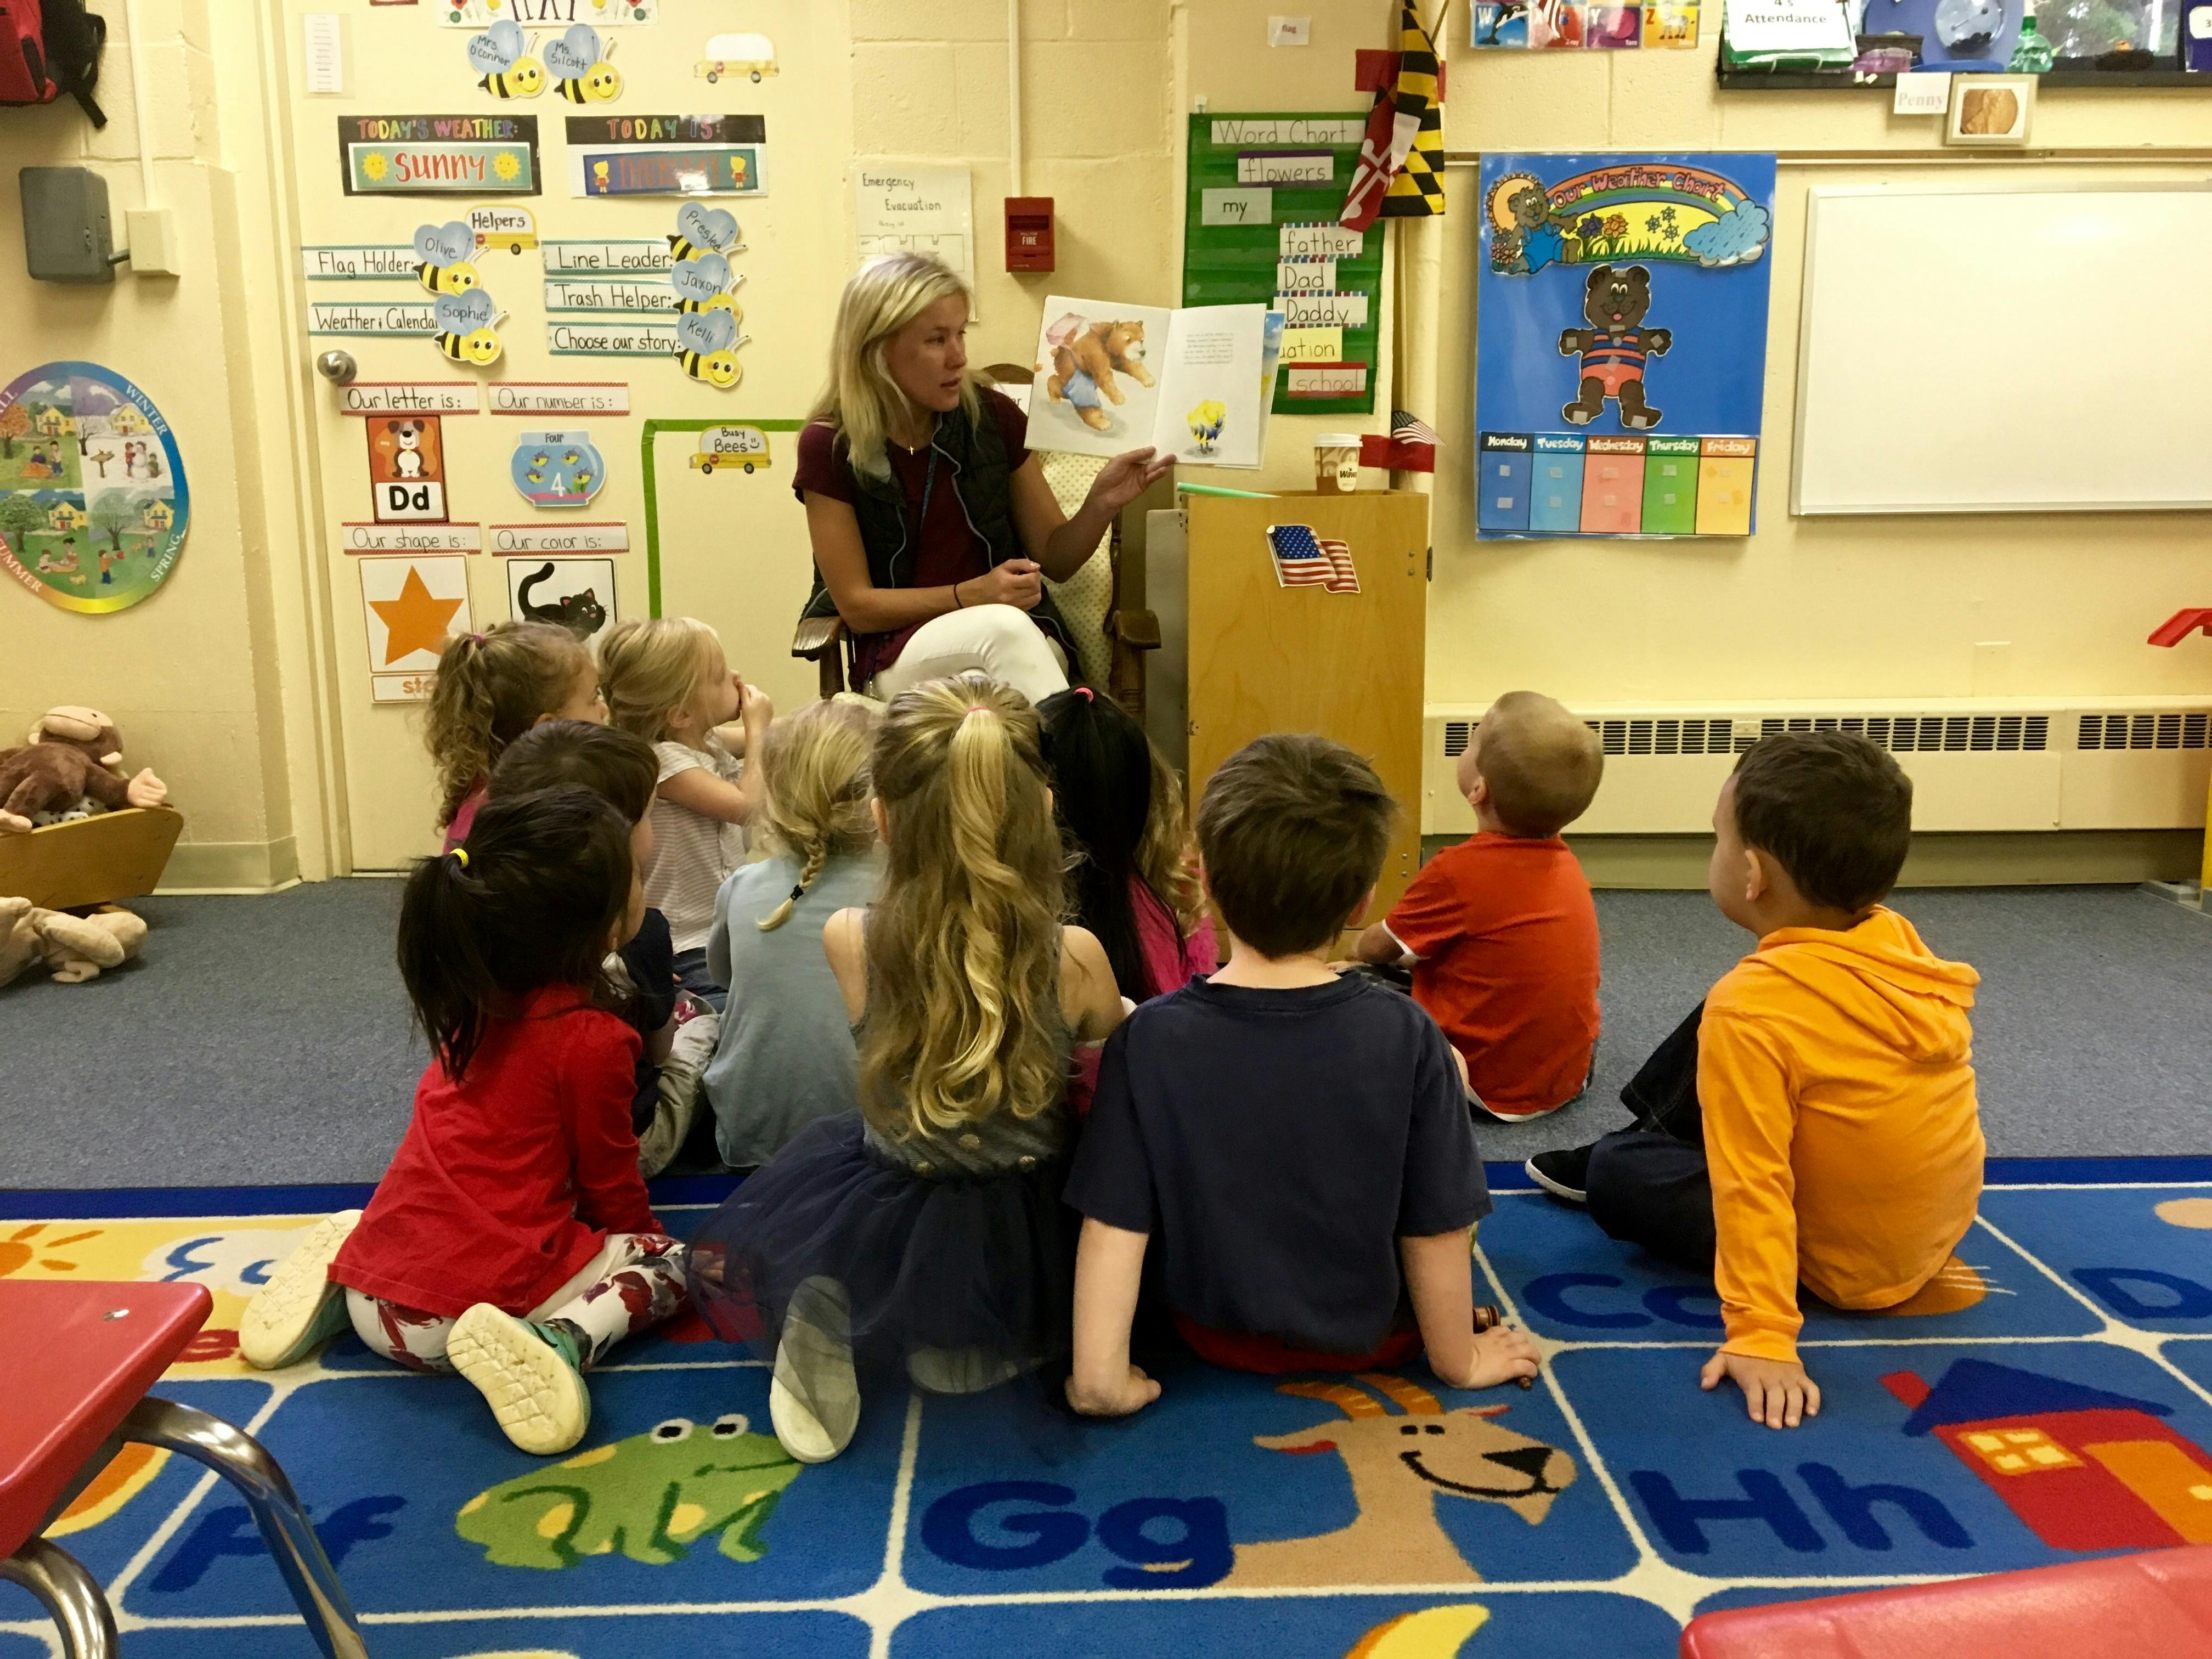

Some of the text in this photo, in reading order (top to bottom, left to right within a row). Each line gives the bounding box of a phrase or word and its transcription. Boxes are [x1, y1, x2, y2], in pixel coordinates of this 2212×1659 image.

[1478, 7, 1492, 24] W
[1591, 8, 1601, 25] Y
[1646, 8, 1655, 25] Z
[1745, 14, 1827, 23] Attendance
[1282, 24, 1297, 34] flag
[477, 35, 499, 51] Mrs.
[555, 42, 571, 56] Ms.
[550, 52, 588, 70] Silcott
[1898, 92, 1945, 109] Penny
[357, 119, 518, 139] TODAY'S WEATHER:
[607, 119, 721, 139] TODAY IS:
[1218, 120, 1347, 144] Word Chart
[619, 155, 721, 189] THURAY
[1245, 157, 1326, 183] flowers
[862, 173, 915, 191] Emergency
[1553, 167, 1726, 209] Our Weather Chart
[885, 196, 941, 211] Evacuation
[1223, 201, 1248, 222] my
[472, 212, 526, 230] Helpers
[425, 238, 458, 259] Olive
[1022, 236, 1037, 245] FIRE
[1285, 231, 1356, 253] father
[318, 251, 414, 279] Flag Holder:
[558, 246, 673, 269] Line Leader:
[681, 270, 721, 294] Jaxon
[1285, 266, 1324, 289] Dad
[554, 284, 672, 312] Trash Helper:
[315, 308, 375, 330] Weather
[442, 304, 487, 323] Sophie
[1286, 298, 1349, 325] Daddy
[555, 327, 681, 356] Choose our story:
[687, 319, 715, 343] Kelli
[1296, 369, 1359, 392] school
[0, 390, 18, 413] LL
[348, 387, 461, 409] Our letter is:
[498, 388, 613, 409] Our number is:
[126, 384, 168, 436] WINTER
[545, 433, 564, 444] Four
[721, 427, 745, 439] Busy
[1488, 436, 1527, 450] Monday
[714, 438, 748, 453] Bees
[1537, 438, 1584, 452] Tuesday
[1589, 439, 1644, 453] Wednesday
[1649, 439, 1699, 454] Thursday
[1707, 441, 1751, 455] Friday
[551, 472, 566, 497] 4
[389, 485, 430, 511] Dd
[353, 527, 466, 553] Our shape is:
[498, 530, 602, 550] Our color is:
[151, 533, 181, 583] SPRING
[1629, 1462, 1976, 1555] Hh
[922, 1481, 1236, 1590] Gg
